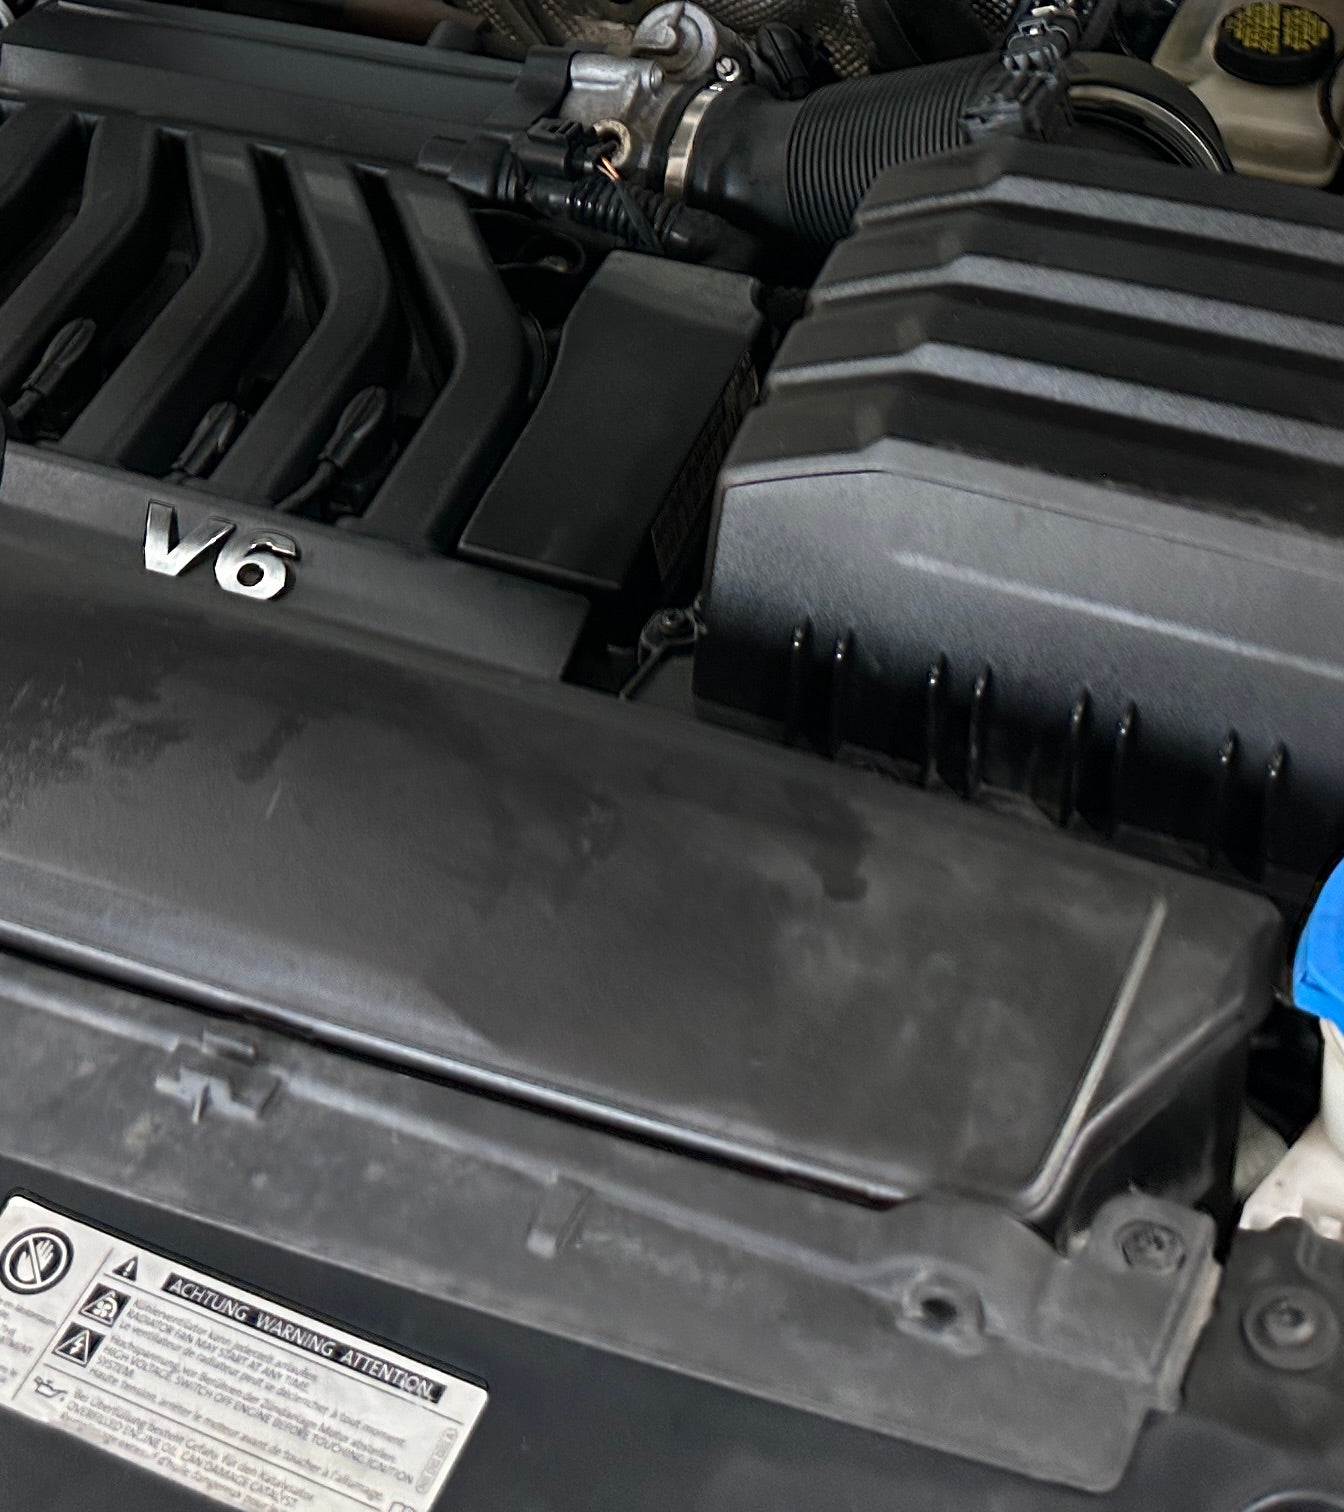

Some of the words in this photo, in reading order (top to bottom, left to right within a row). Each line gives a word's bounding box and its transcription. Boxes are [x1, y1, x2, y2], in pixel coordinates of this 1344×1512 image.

[143, 498, 296, 602] V6
[167, 1276, 252, 1321] ACHTUNG
[250, 1311, 339, 1357] WARNING
[337, 1347, 436, 1398] ATTENTION
